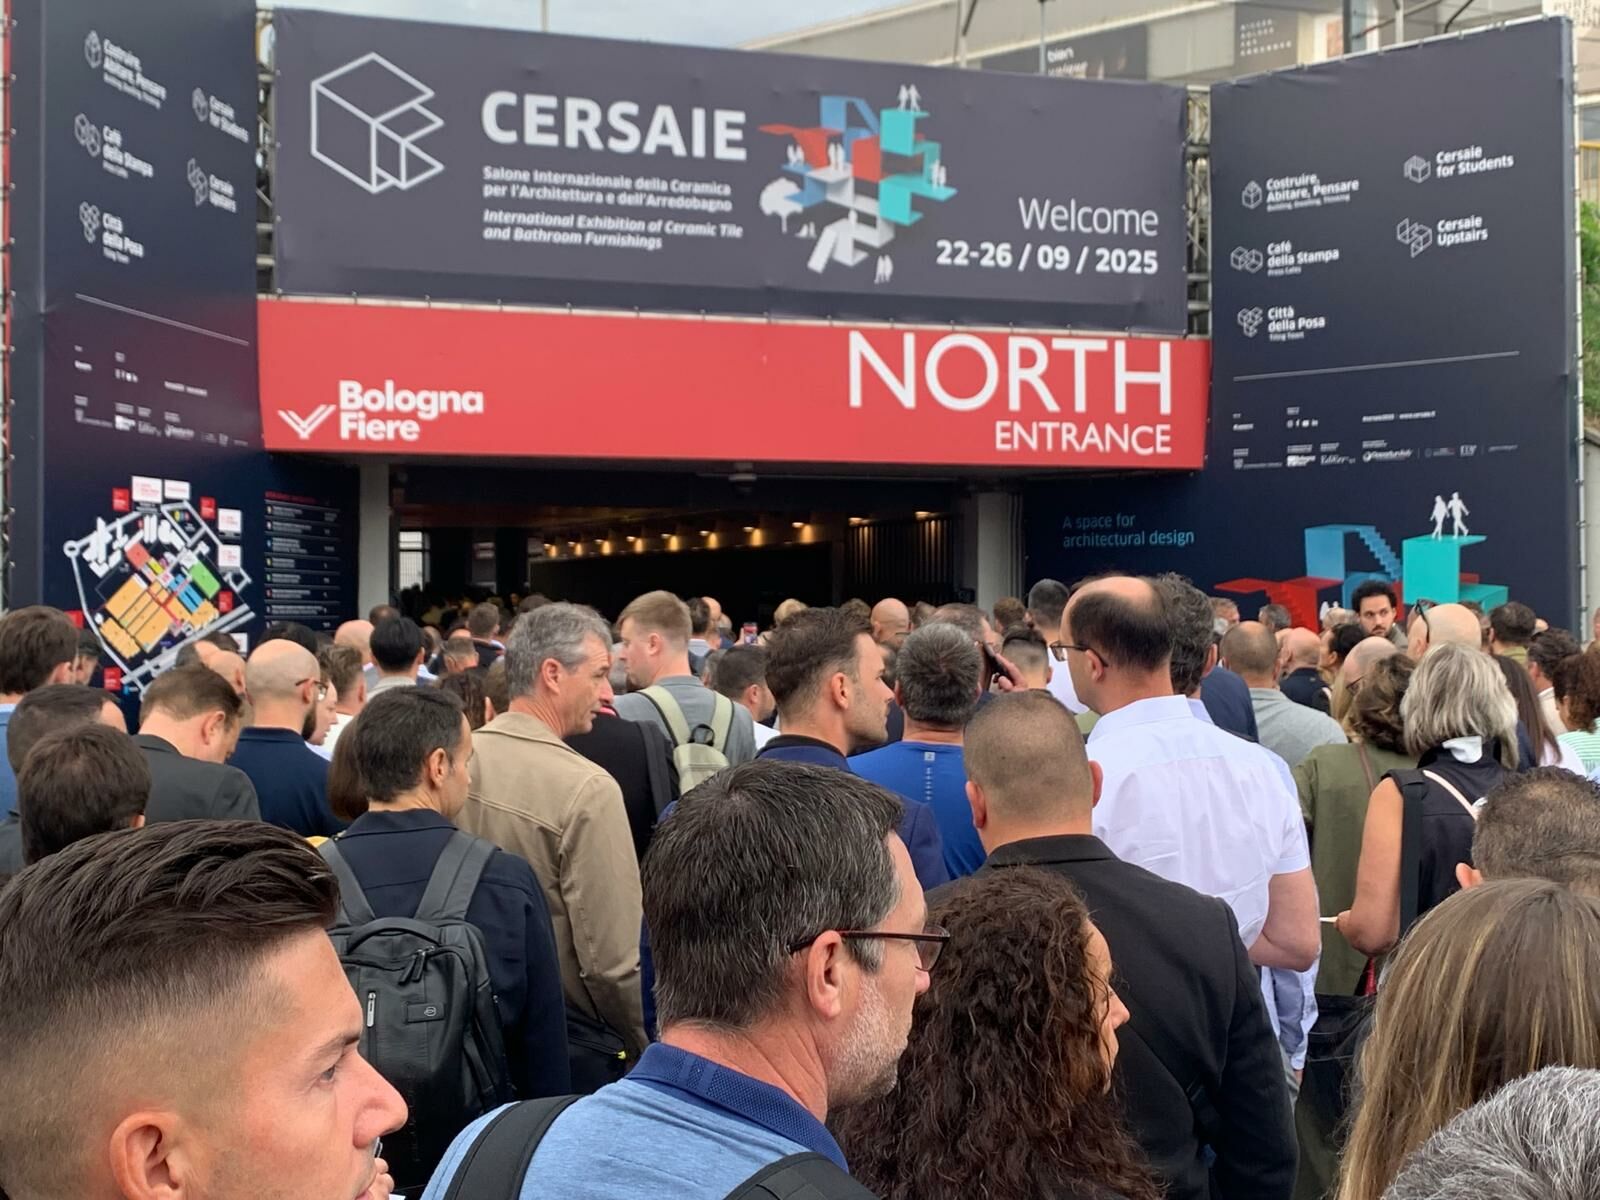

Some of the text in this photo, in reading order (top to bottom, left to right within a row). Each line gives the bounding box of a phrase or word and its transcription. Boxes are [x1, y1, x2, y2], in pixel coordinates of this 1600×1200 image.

[481, 90, 748, 161] CERSAIE
[483, 165, 731, 196] Salone Internazionale della Ceramica
[1436, 155, 1514, 178] for Students
[483, 182, 733, 213] per l'Architettura e dell'Arredobagno
[1313, 179, 1360, 197] Pensare
[483, 208, 743, 238] International Exhibition of Ceramic Tile
[1018, 197, 1159, 236] Welcome
[483, 224, 663, 250] and Bathroom Furnishings
[1267, 240, 1292, 256] Café
[1437, 228, 1488, 247] Upstairs
[935, 239, 1159, 275] 22-26 / 09 / 2025
[1297, 248, 1340, 265] Stampa
[1298, 316, 1326, 331] Posa
[849, 331, 1172, 415] NORTH
[339, 379, 484, 421] Bologna
[340, 411, 420, 441] Fiere
[995, 421, 1172, 456] ENTRANCE
[1062, 513, 1136, 530] A space for
[1063, 529, 1194, 547] architectural design
